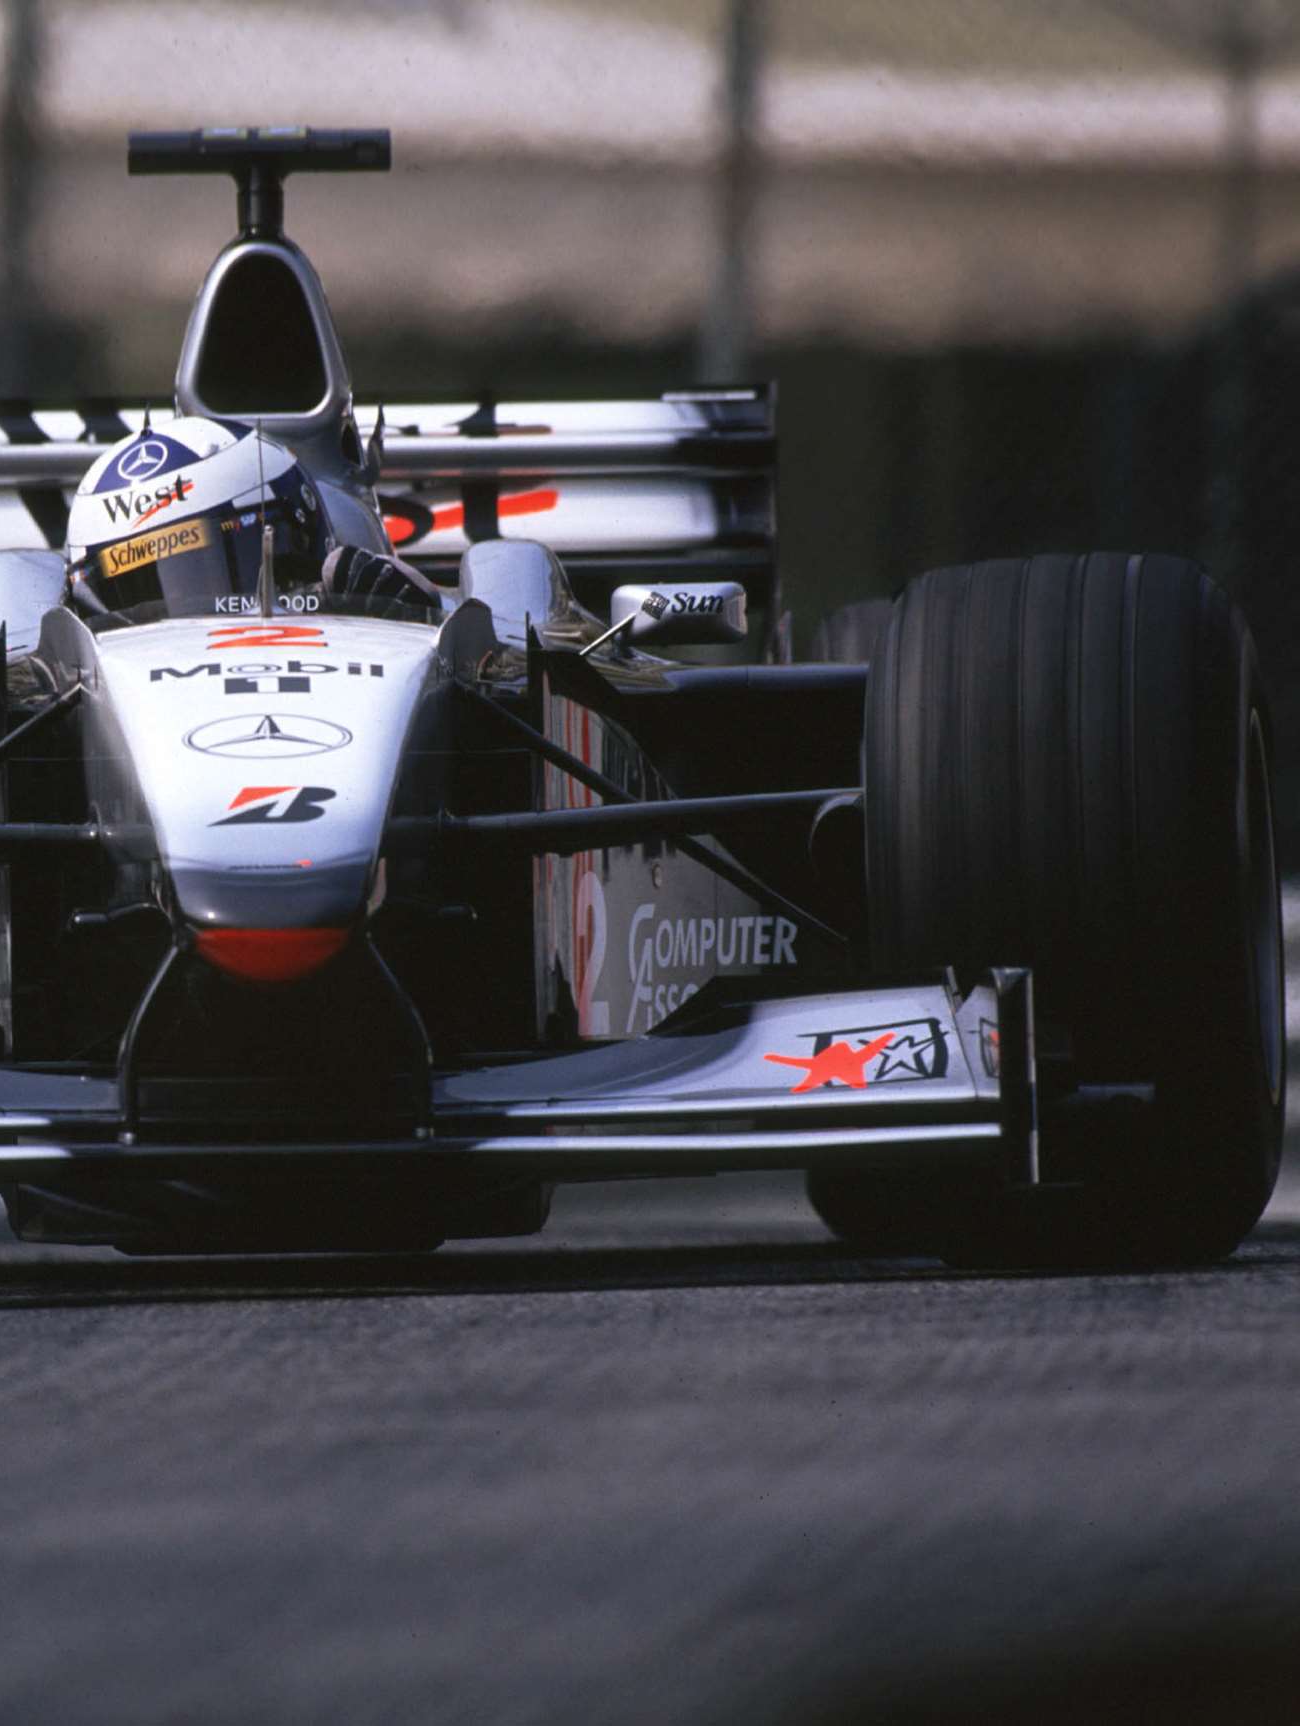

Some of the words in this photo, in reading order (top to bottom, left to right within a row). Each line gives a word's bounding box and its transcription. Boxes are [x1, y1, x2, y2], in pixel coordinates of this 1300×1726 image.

[103, 474, 193, 524] West
[108, 524, 200, 575] Schweppes
[215, 595, 319, 612] KENOOD
[672, 592, 725, 614] Sun
[206, 626, 329, 650] 2
[150, 661, 384, 681] Mobil
[576, 871, 610, 1036] 2
